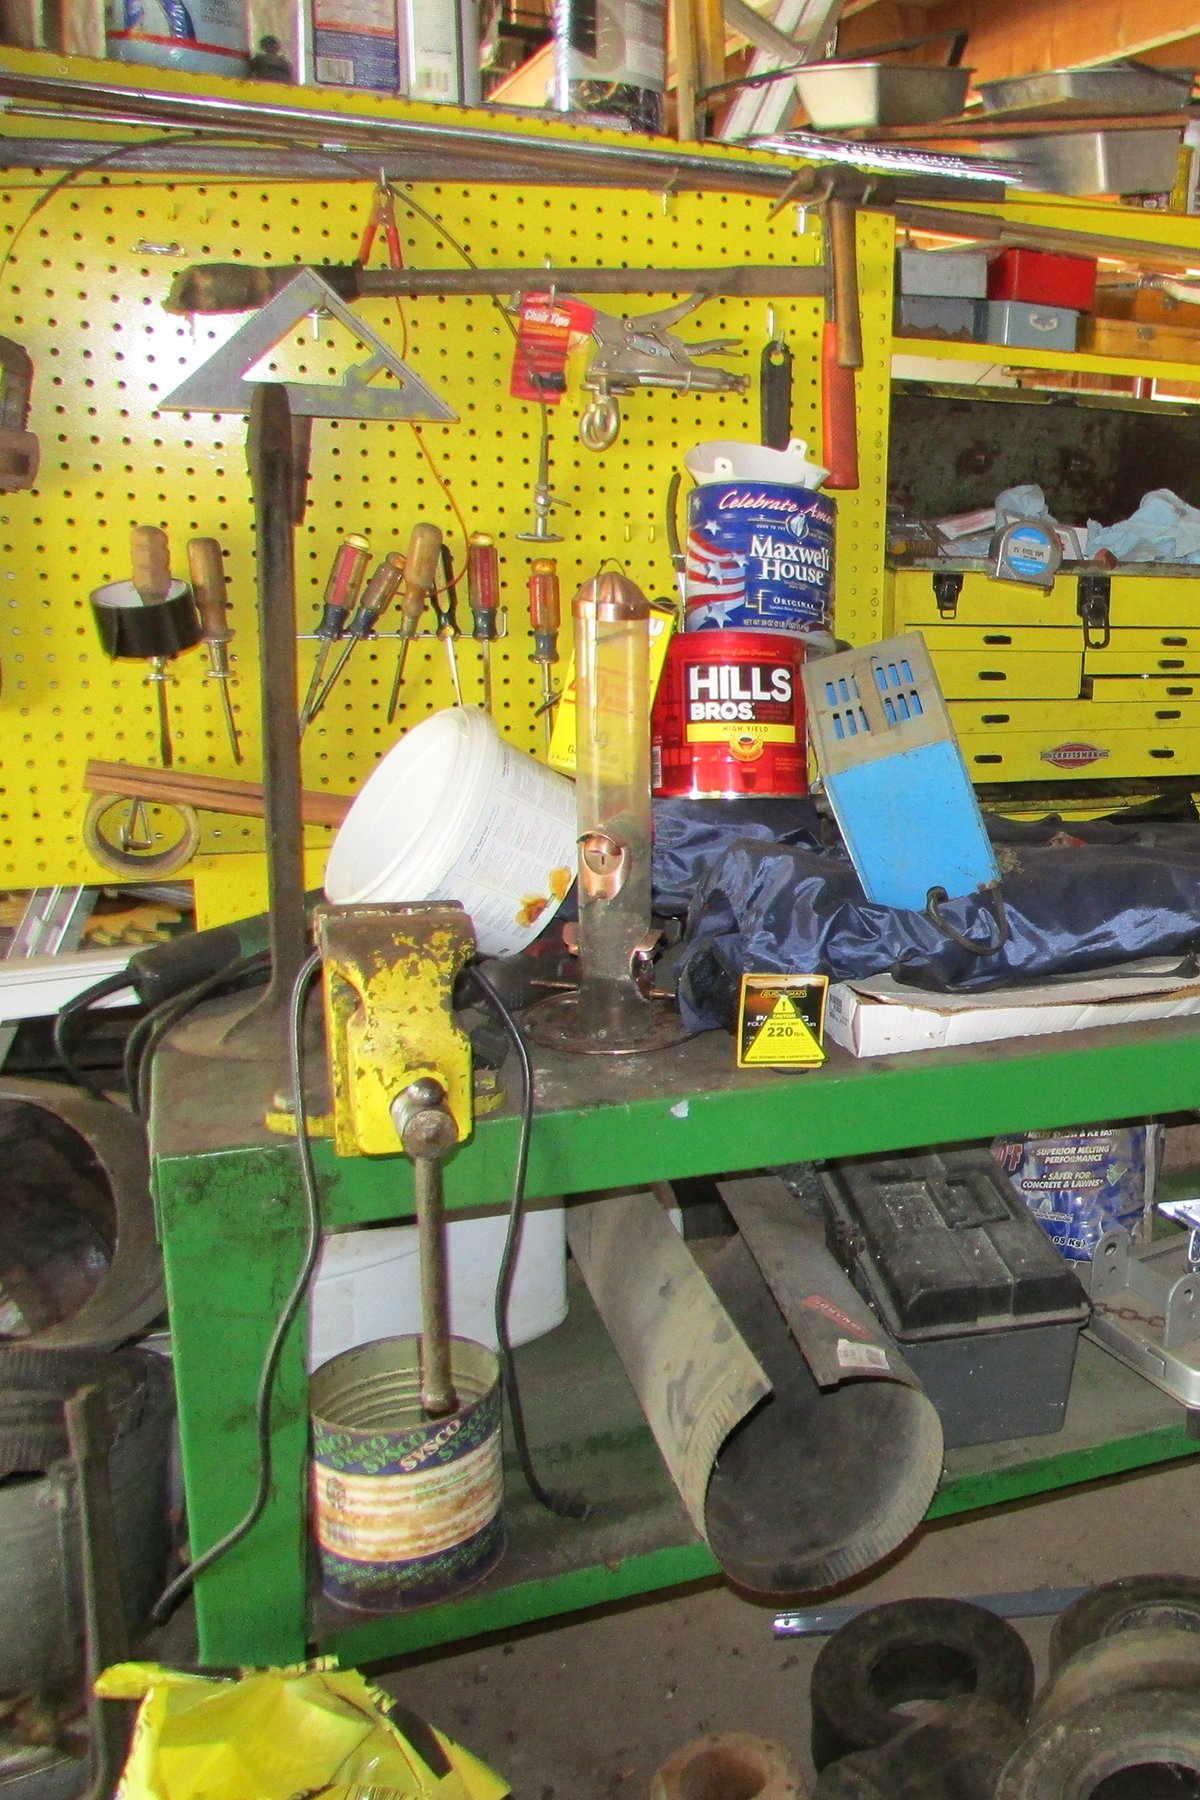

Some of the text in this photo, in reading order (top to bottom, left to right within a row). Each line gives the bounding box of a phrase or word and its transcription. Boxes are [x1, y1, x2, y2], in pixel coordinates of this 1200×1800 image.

[525, 309, 570, 328] Chair Tips
[719, 489, 799, 513] Celebrate
[749, 534, 830, 571] Maxwell
[761, 557, 824, 586] House
[773, 596, 815, 610] ORIGINAL
[690, 666, 792, 702] HILLS
[767, 1027, 793, 1037] 220
[1036, 1145, 1110, 1156] SUPERIOR MELTING
[1044, 1154, 1103, 1164] PERFORMANCE
[1048, 1171, 1091, 1180] SAFER FOR
[1022, 1180, 1061, 1189] CONCRETE
[1062, 1180, 1069, 1188] &
[400, 1419, 461, 1471] SYSCO
